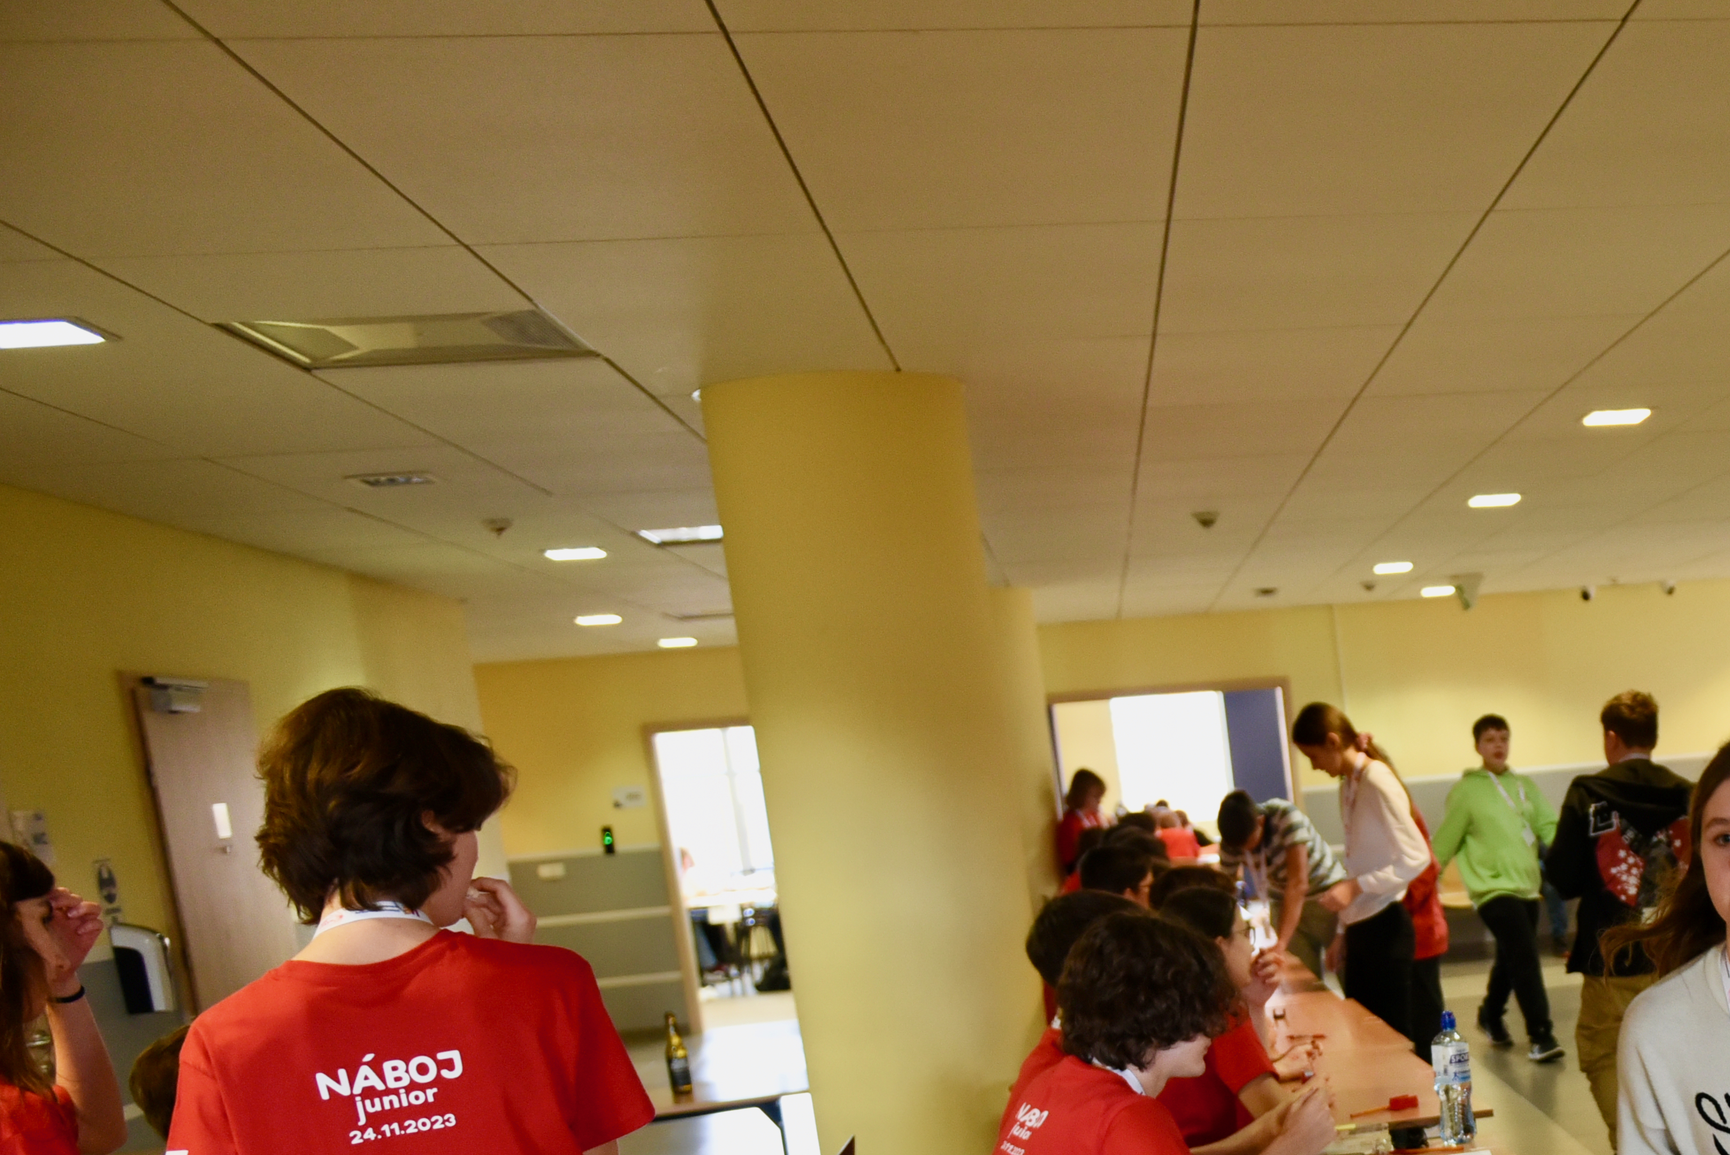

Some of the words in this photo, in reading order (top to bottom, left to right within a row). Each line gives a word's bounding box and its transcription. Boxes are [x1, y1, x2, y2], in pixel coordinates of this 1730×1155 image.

[316, 1050, 463, 1100] NÁBOJ
[355, 1088, 438, 1125] junior
[349, 1114, 457, 1145] 24.11.2023
